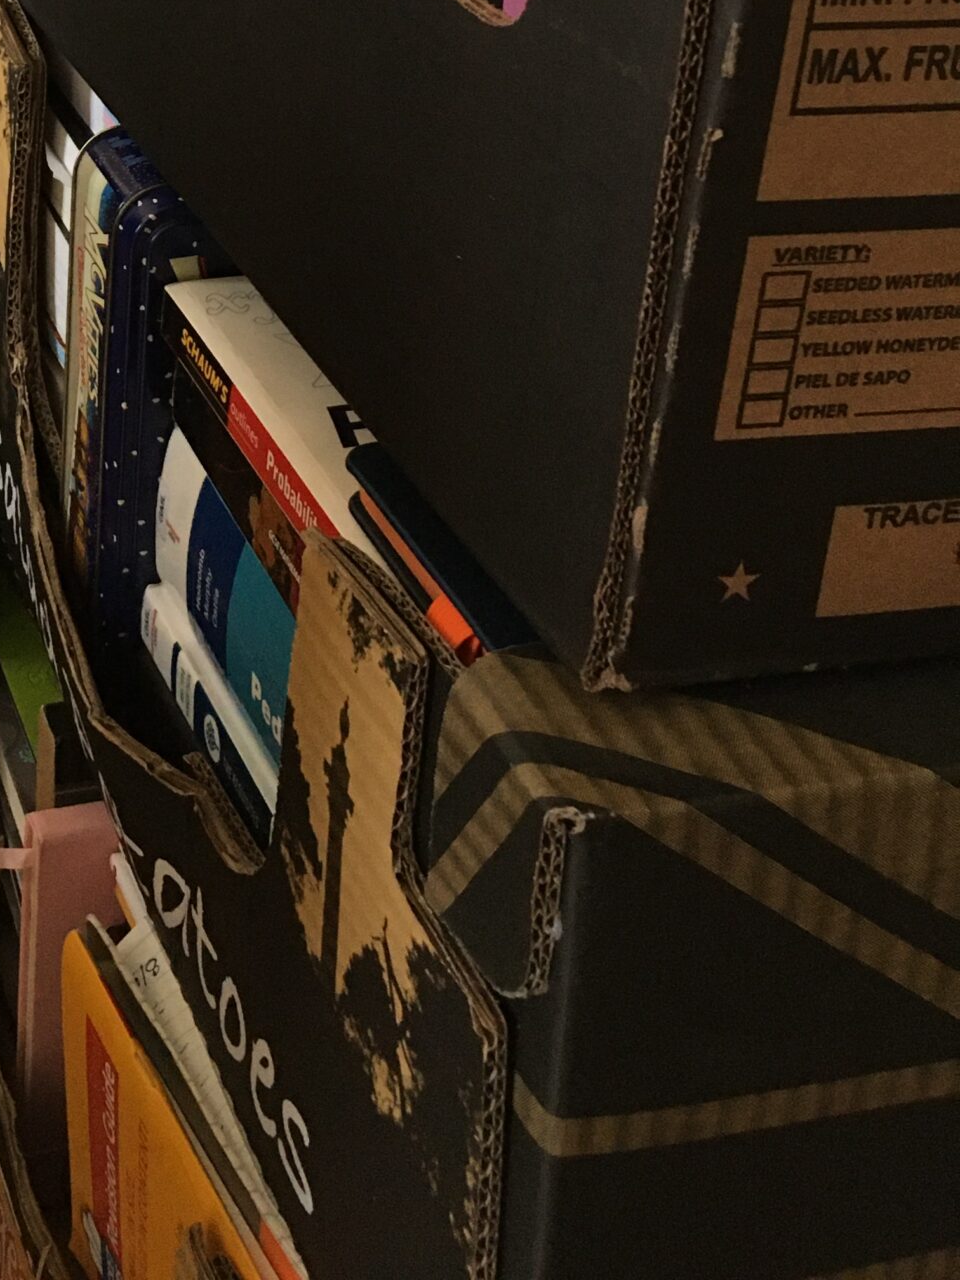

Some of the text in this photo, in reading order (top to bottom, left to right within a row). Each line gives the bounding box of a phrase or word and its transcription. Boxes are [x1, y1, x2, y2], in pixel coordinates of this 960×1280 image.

[806, 47, 892, 85] MAX.
[774, 244, 872, 266] VARIETY:
[812, 276, 882, 294] SEEDED
[806, 308, 892, 326] SEEDLESS
[801, 340, 873, 358] YELLOW
[180, 327, 229, 405] SCHAUM'S
[795, 369, 911, 389] PIEL DE SAPO
[789, 404, 848, 421] OTHER
[102, 1061, 116, 1145] Guide
